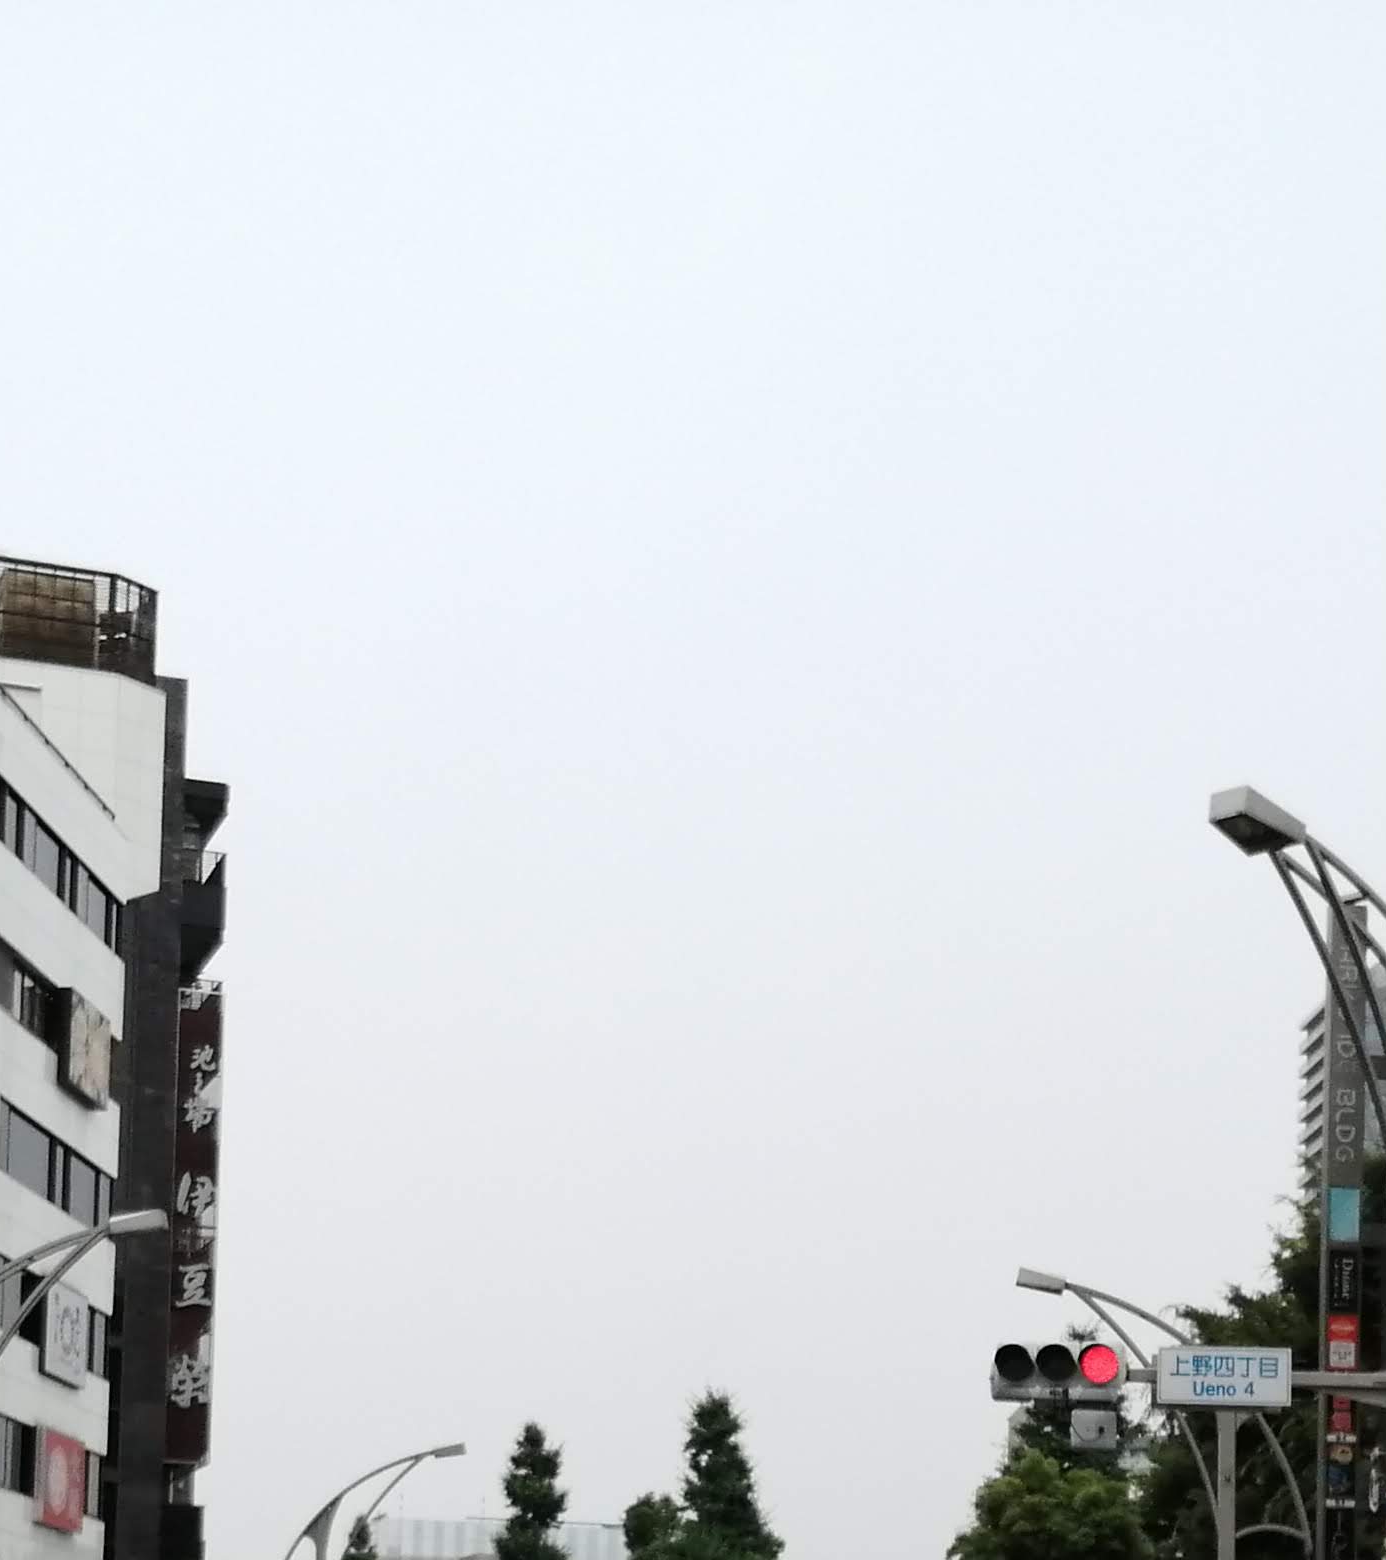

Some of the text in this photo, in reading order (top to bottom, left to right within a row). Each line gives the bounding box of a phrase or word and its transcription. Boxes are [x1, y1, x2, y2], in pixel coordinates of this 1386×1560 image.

[1335, 1088, 1356, 1162] BLDG
[1169, 1354, 1279, 1379] 上野四丁目
[1192, 1380, 1255, 1397] Ueno 4
